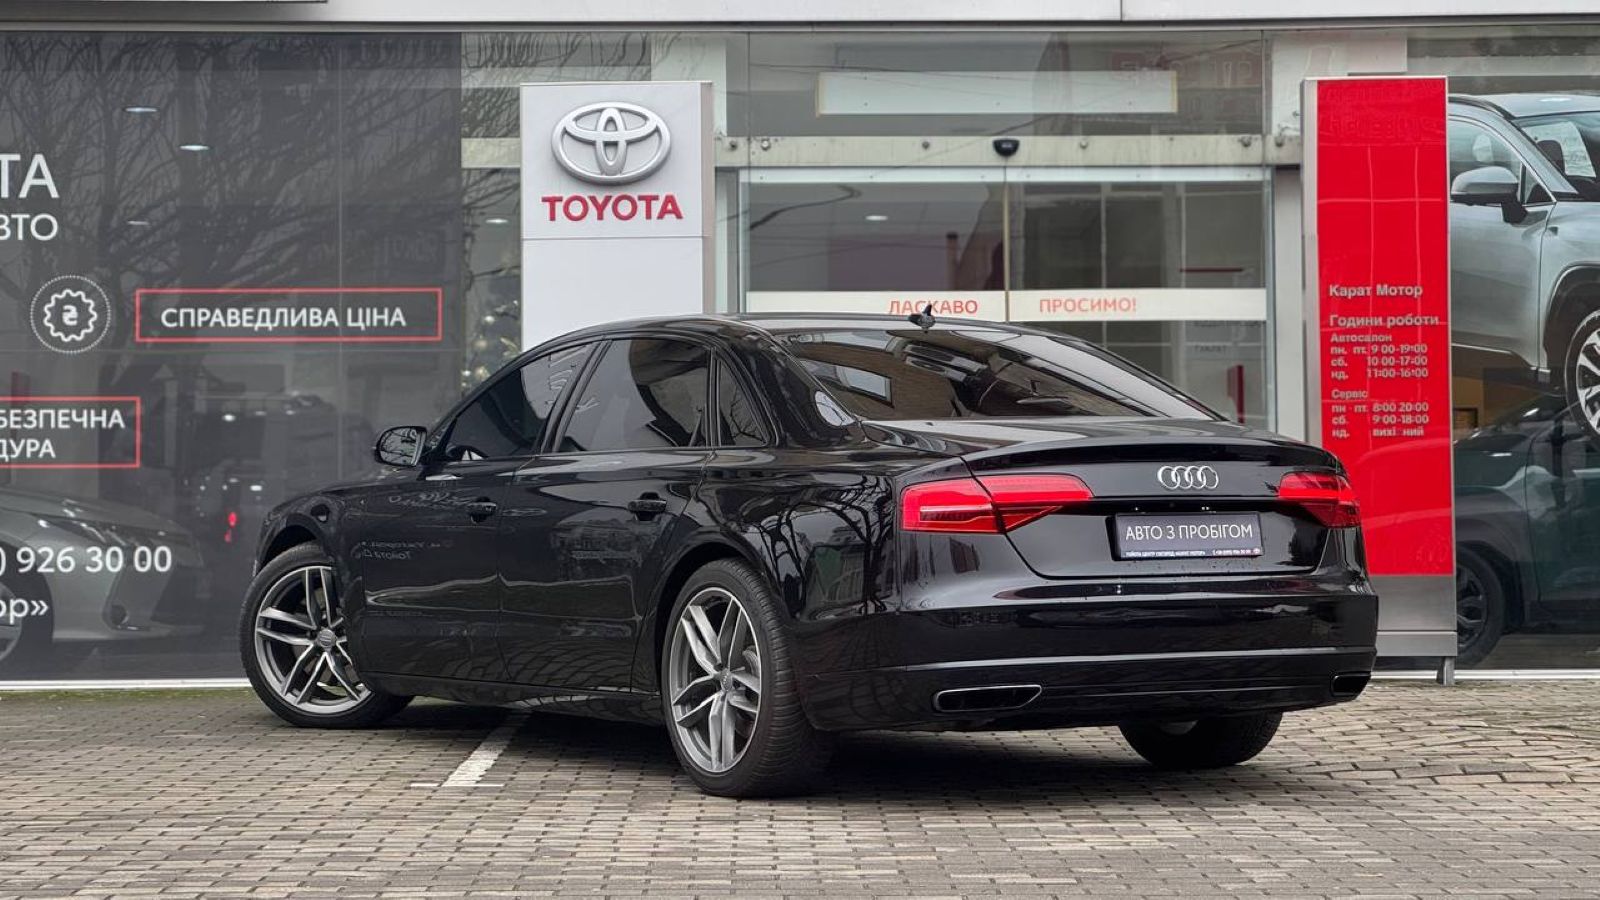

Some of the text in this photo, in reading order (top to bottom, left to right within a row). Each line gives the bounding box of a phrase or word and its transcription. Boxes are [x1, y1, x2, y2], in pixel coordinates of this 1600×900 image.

[541, 193, 683, 222] TOYOTA
[1329, 284, 1423, 299] Карат Мотор
[1039, 296, 1137, 314] ПРОСИМО!
[161, 306, 406, 332] СПРАВЕДЛИВА ЦІНА
[1329, 312, 1440, 328] Години роботи
[1330, 332, 1392, 343] Автосалон
[1371, 343, 1428, 354] 900-19:00
[1367, 355, 1428, 366] 1000-17:00
[1372, 425, 1424, 437] вихіний
[1125, 525, 1163, 541] АВТО
[1179, 524, 1253, 540] ПРОБІГОМ
[16, 546, 76, 573] 926
[86, 546, 124, 573] 30
[133, 545, 172, 573] 00
